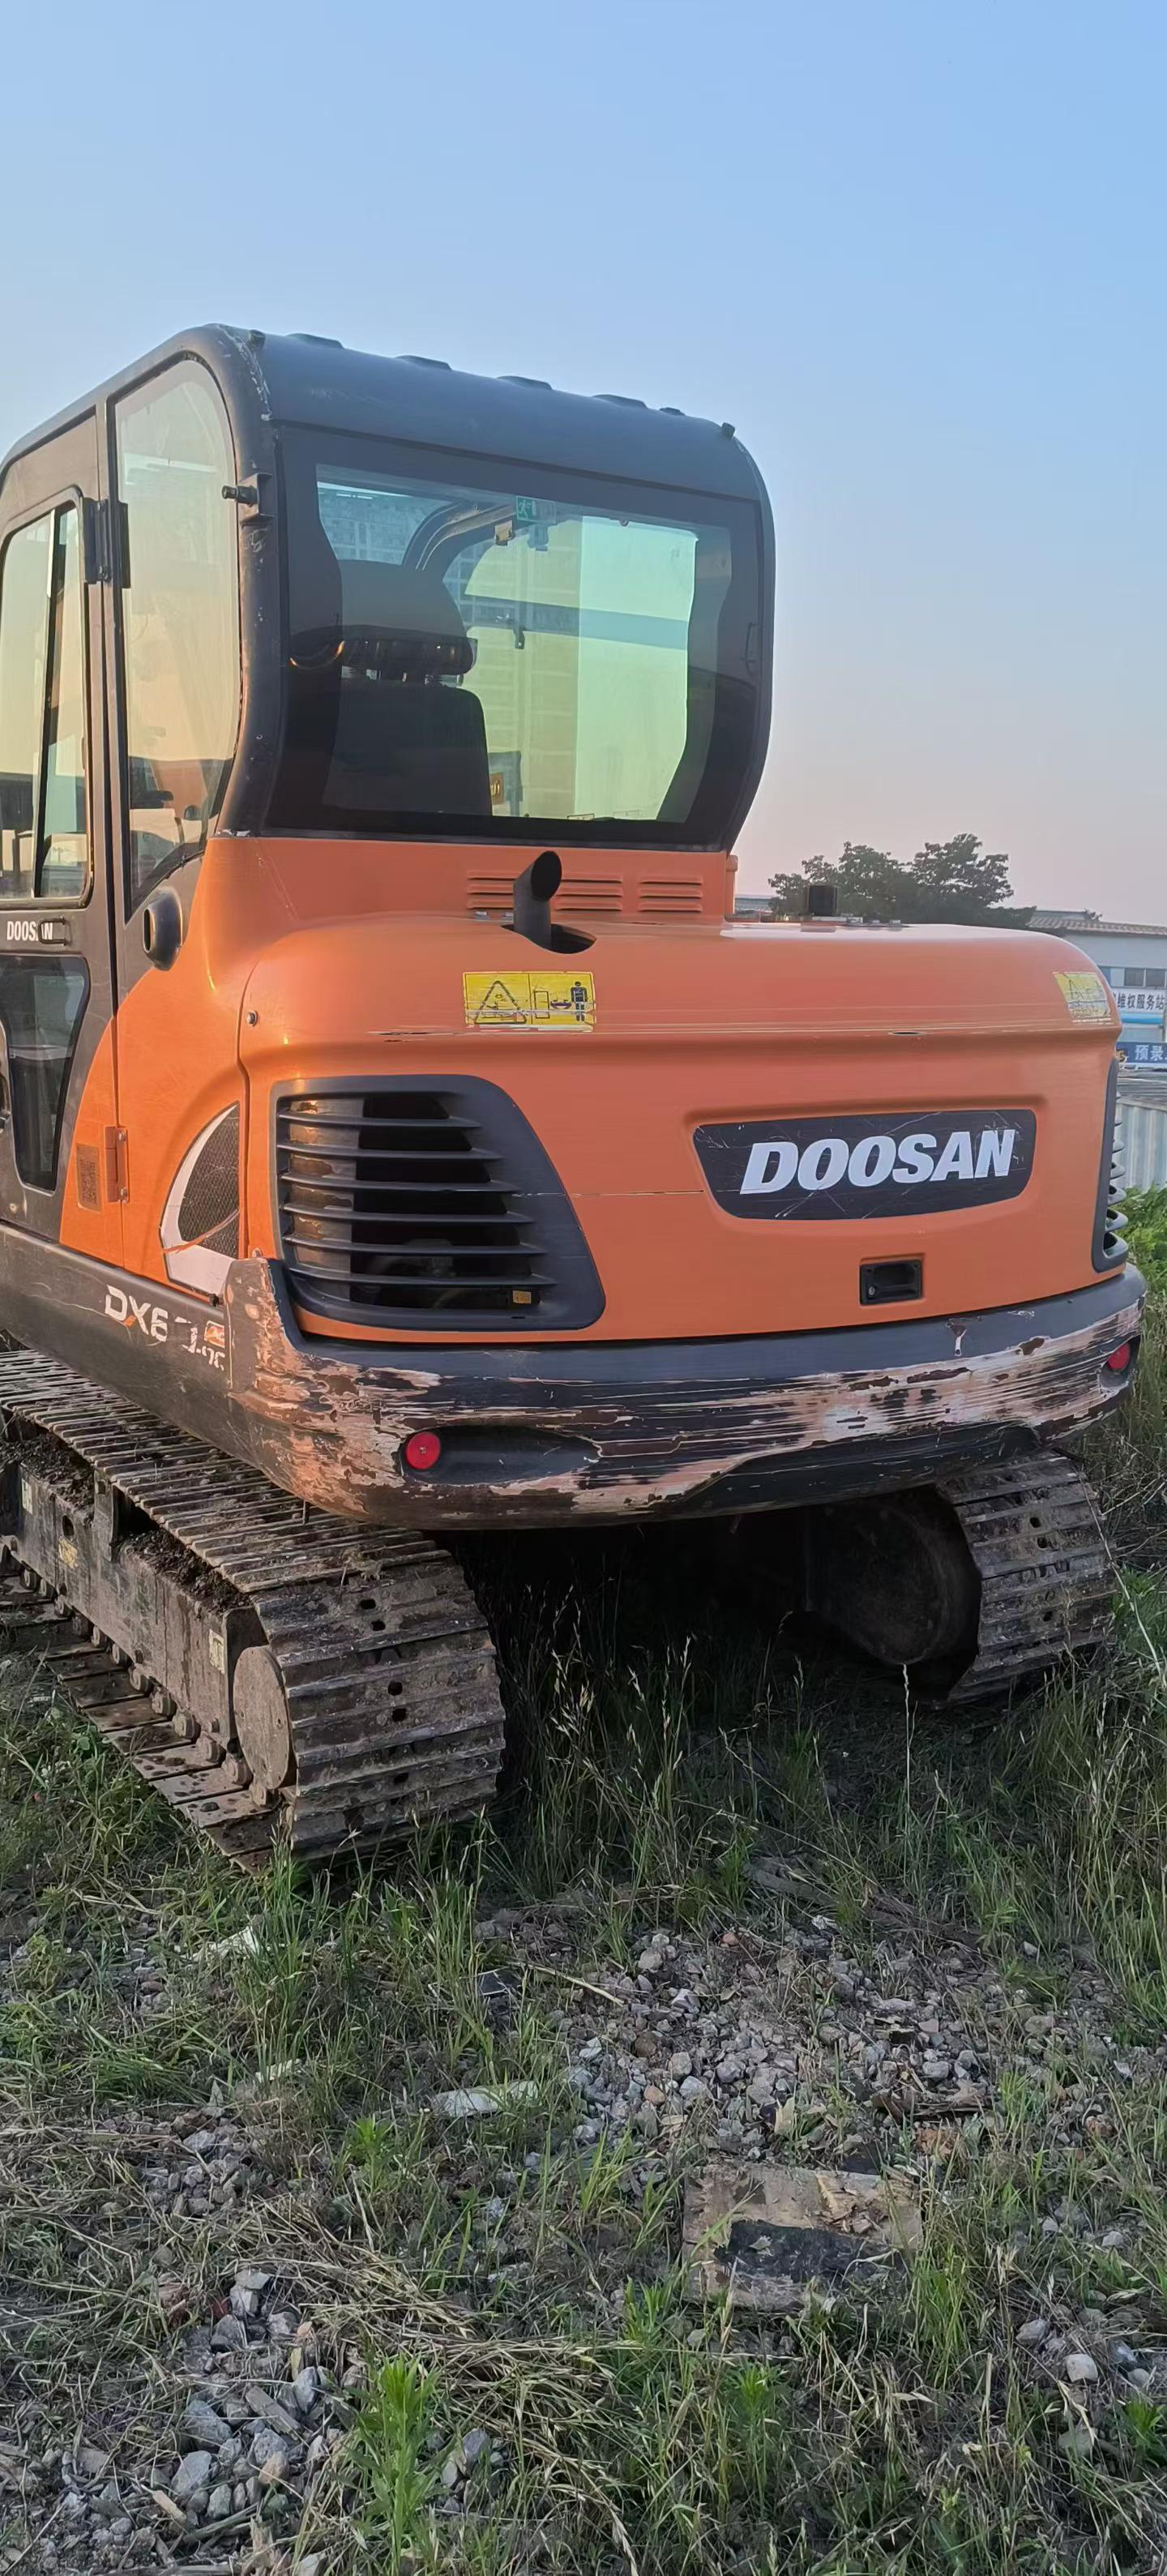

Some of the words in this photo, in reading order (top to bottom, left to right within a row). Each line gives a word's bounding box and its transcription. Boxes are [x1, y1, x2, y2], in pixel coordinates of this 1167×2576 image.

[1113, 991, 1165, 1011] 维权服务站
[1135, 1044, 1167, 1061] 预录
[739, 1129, 1015, 1195] DOOSAN
